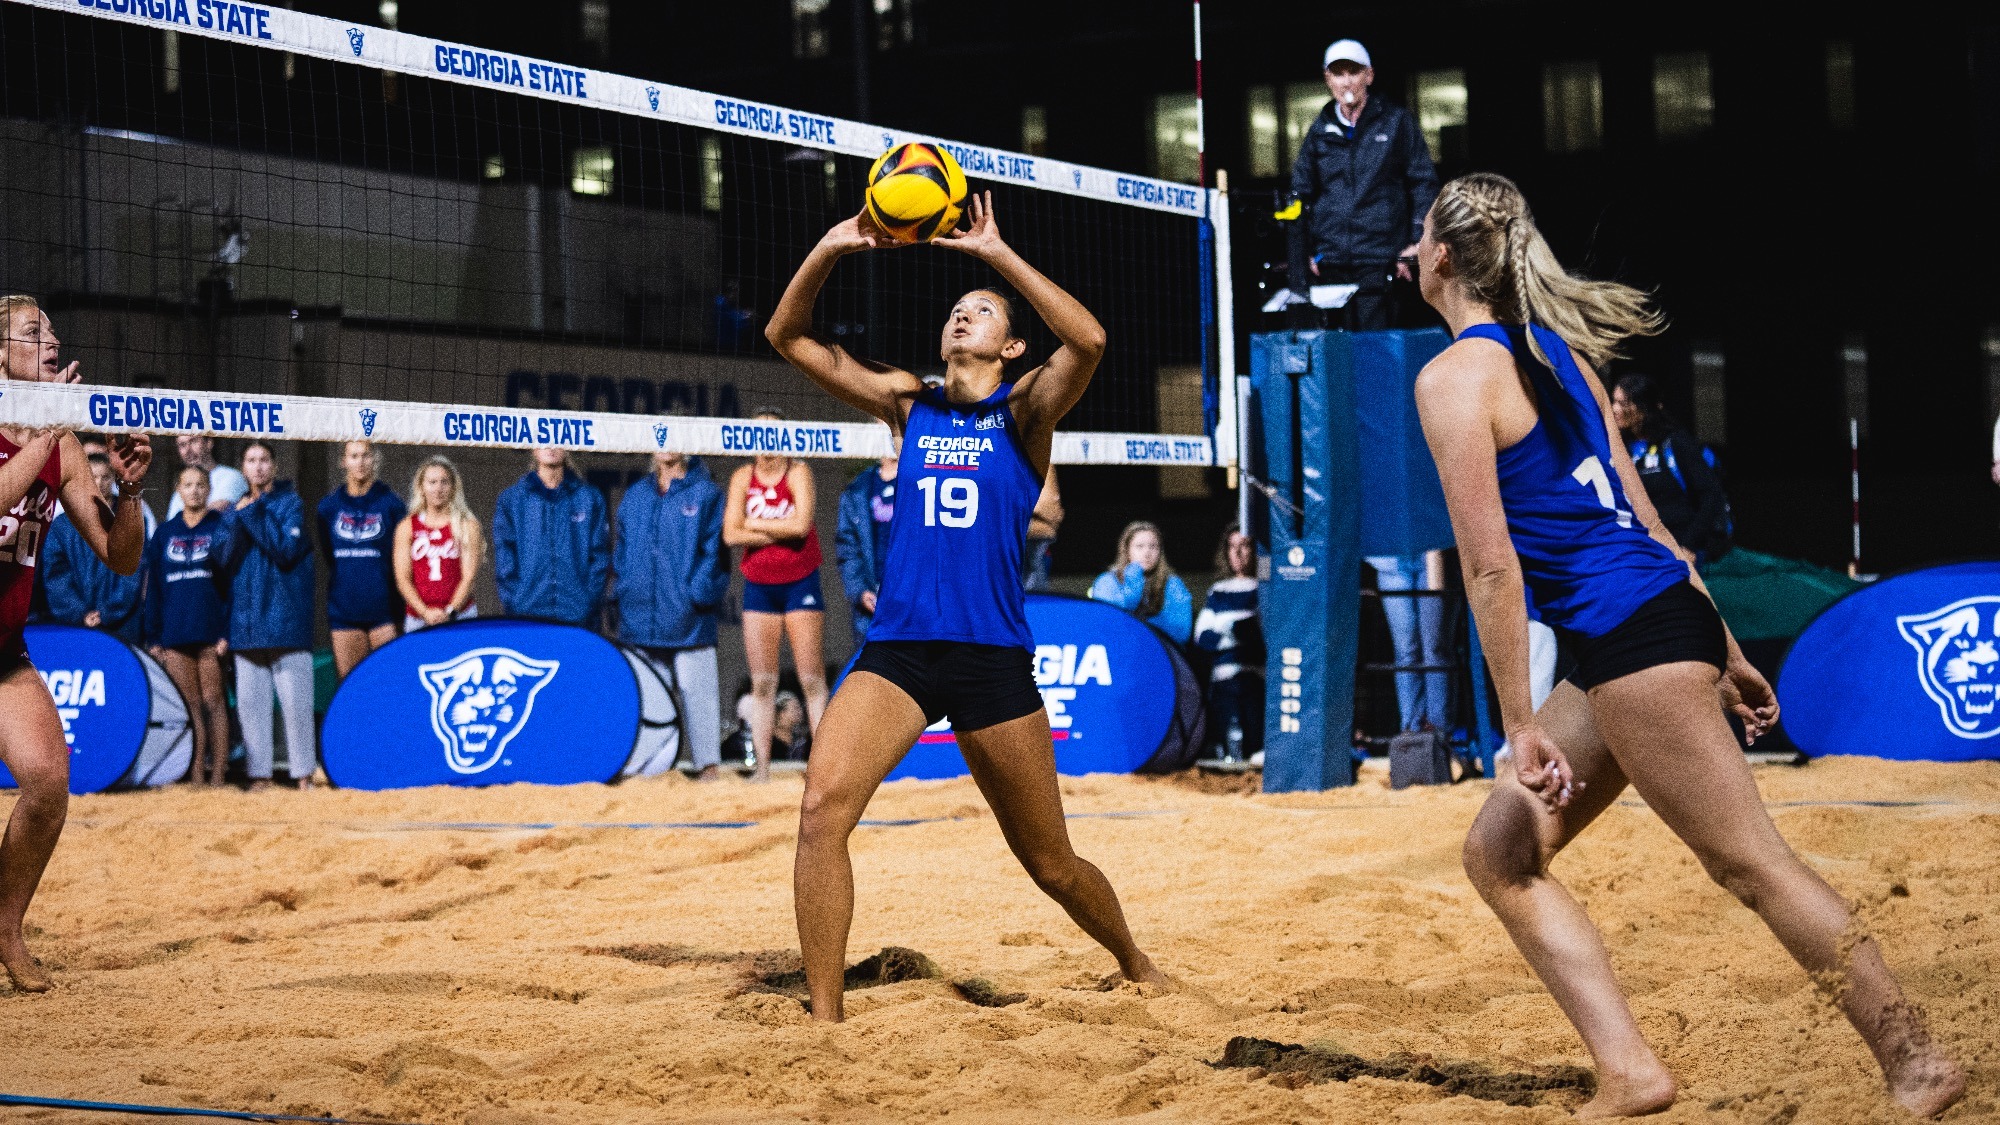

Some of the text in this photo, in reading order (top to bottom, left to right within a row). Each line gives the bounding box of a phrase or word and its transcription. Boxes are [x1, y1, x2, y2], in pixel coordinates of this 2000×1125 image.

[77, 0, 272, 39] RGIA STATE
[435, 45, 587, 98] GEORGIA STATE
[715, 99, 836, 144] GEORGIA STATE
[938, 143, 1036, 181] ORGIA STATE
[1118, 178, 1197, 210] GEORGIA STATE
[89, 393, 284, 432] GEORGIA STATE
[444, 413, 595, 446] GEORGIA STATE
[722, 425, 843, 453] GEORGIA STATE
[917, 435, 994, 452] GEORGIA
[925, 450, 980, 466] STATE
[10, 487, 54, 522] wls
[917, 476, 979, 528] 19
[1571, 455, 1633, 528] 1
[0, 515, 42, 568] 20
[427, 557, 442, 581] 1
